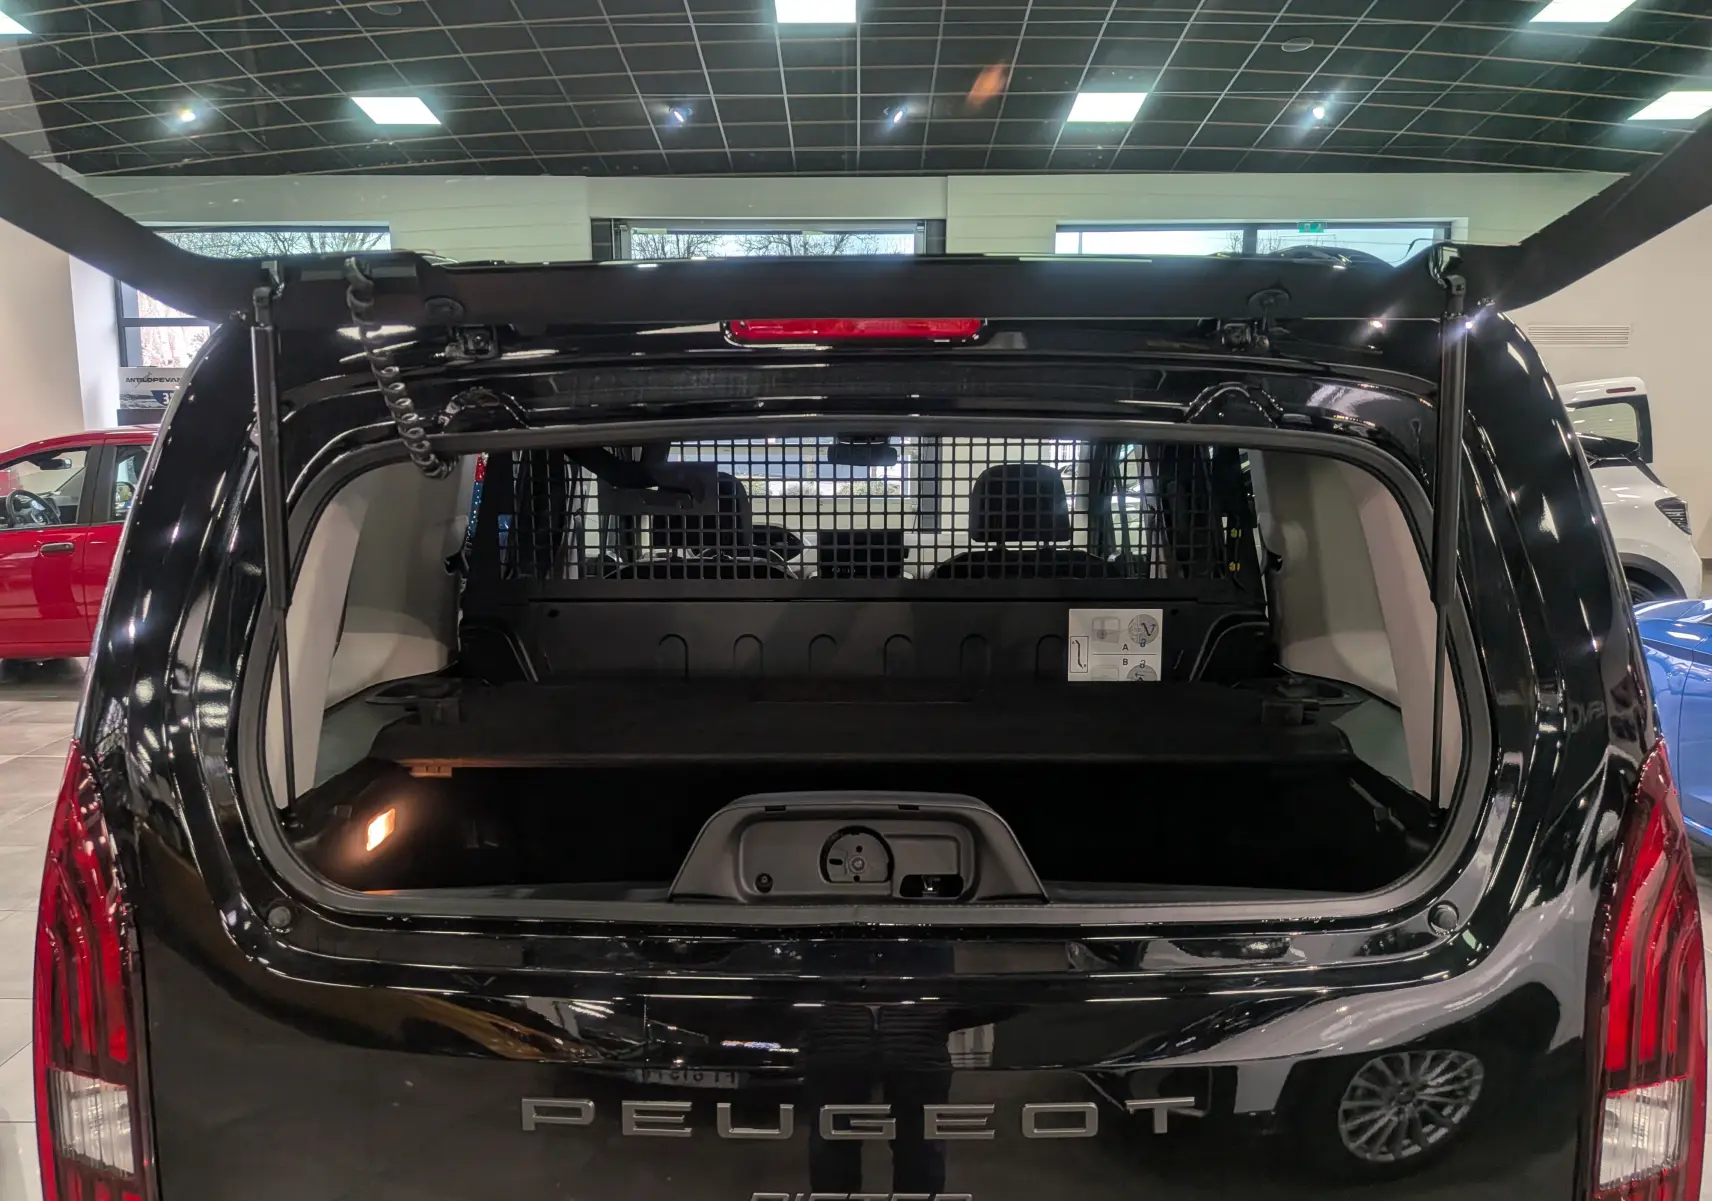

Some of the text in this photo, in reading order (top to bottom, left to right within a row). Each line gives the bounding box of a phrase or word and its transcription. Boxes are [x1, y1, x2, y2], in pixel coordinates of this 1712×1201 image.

[1122, 643, 1129, 651] A
[1122, 658, 1129, 666] B
[521, 1096, 1195, 1140] PEUGEOT
